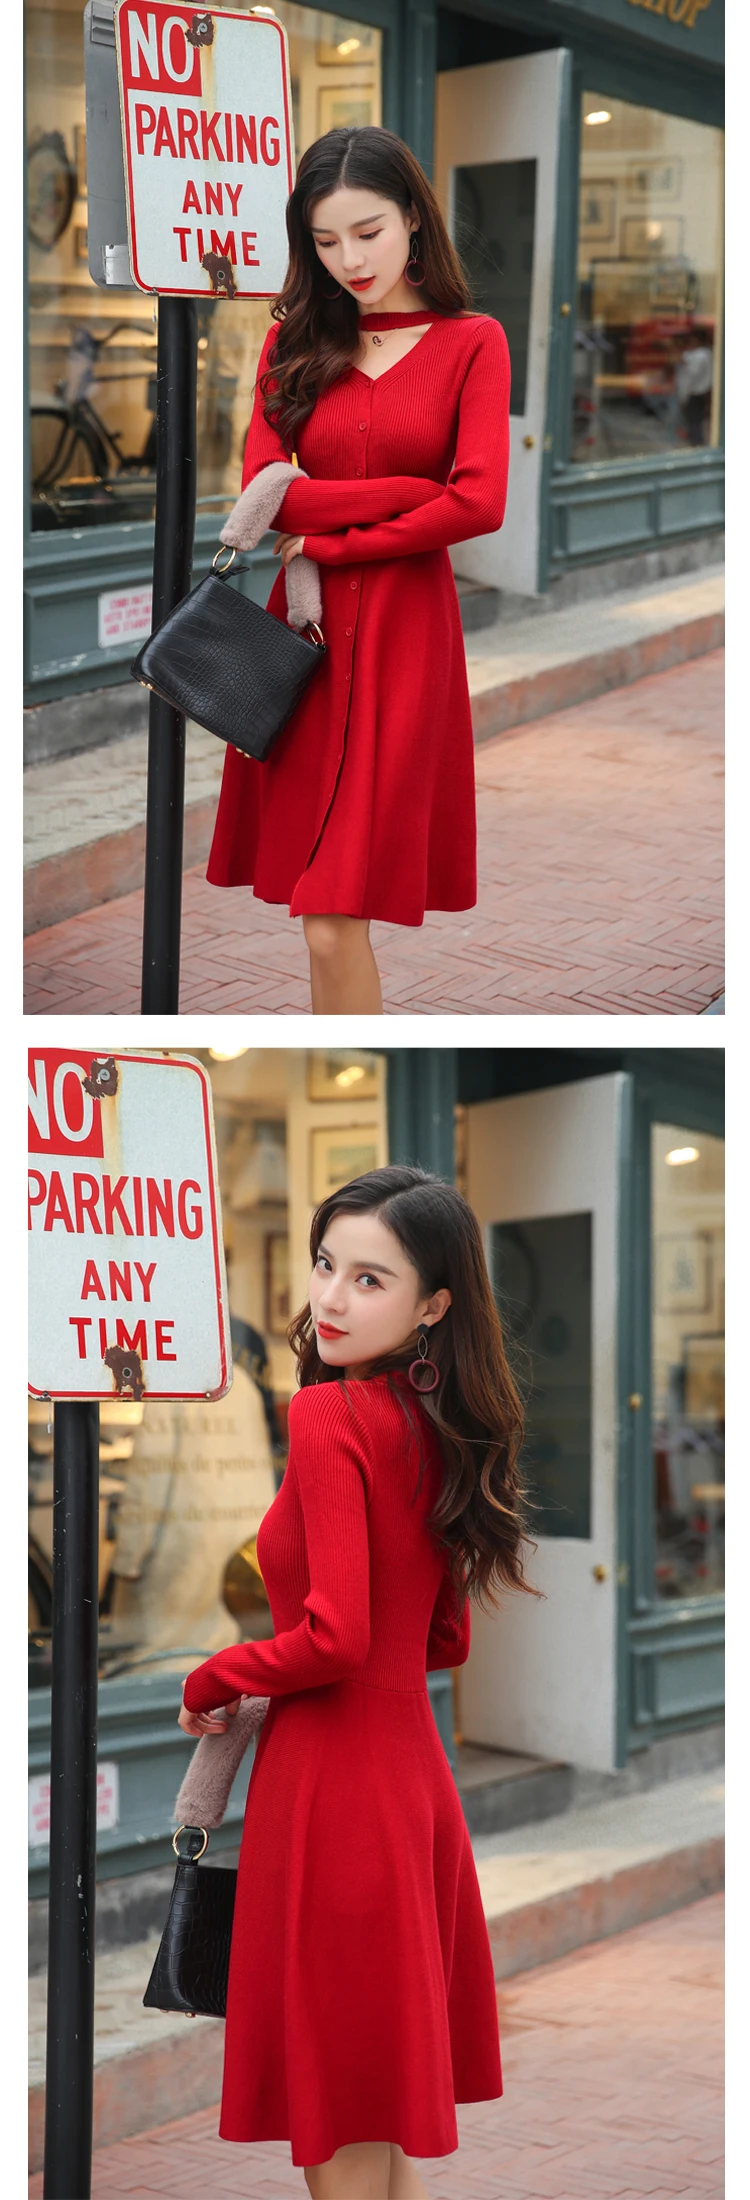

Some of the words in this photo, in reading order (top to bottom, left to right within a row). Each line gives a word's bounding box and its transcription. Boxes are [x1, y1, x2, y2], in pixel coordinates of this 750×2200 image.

[128, 10, 195, 83] NO
[135, 103, 281, 167] PARKING
[182, 180, 243, 217] ANY
[173, 227, 260, 267] TIME
[28, 1169, 204, 1240] PARKING
[80, 1259, 157, 1303] ANY
[69, 1316, 177, 1361] TIME
